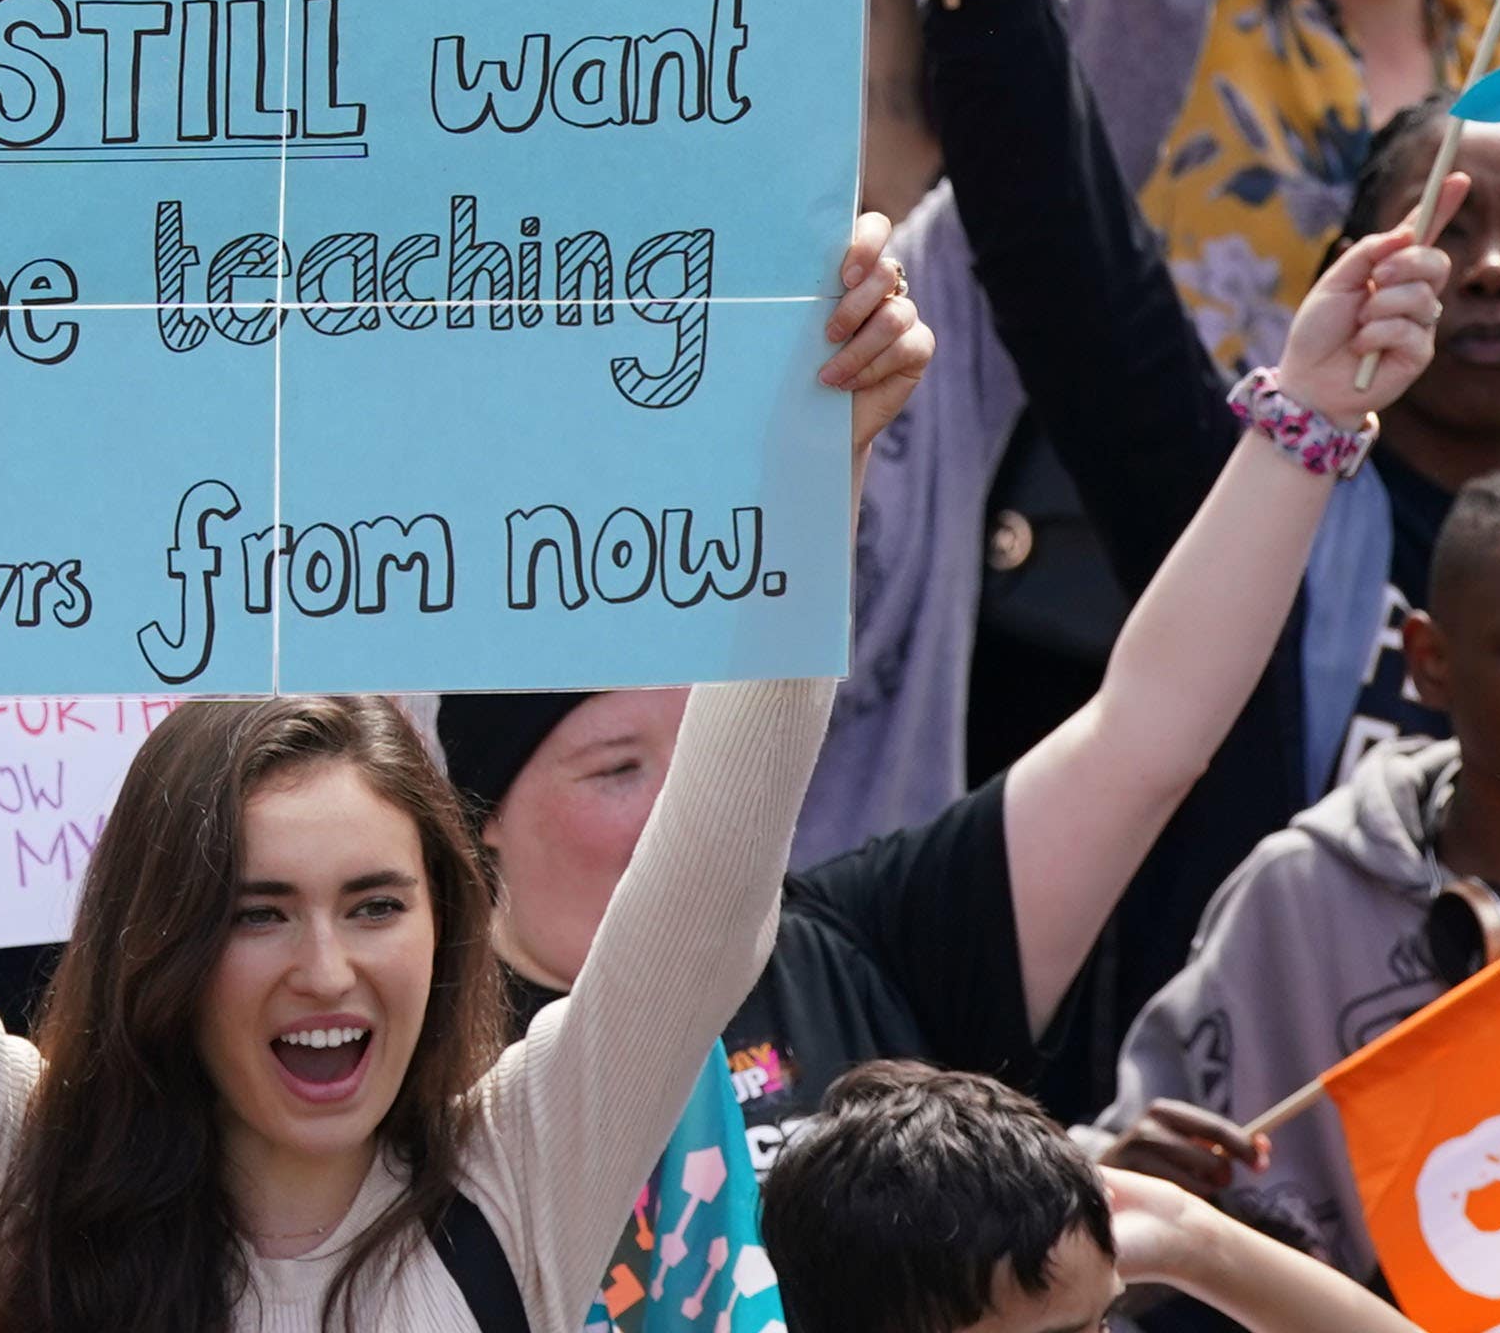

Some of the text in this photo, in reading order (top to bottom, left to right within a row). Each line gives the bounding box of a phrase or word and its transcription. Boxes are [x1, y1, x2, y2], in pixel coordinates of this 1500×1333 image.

[154, 194, 717, 412] teaching
[135, 478, 455, 686] from
[506, 504, 788, 613] now.
